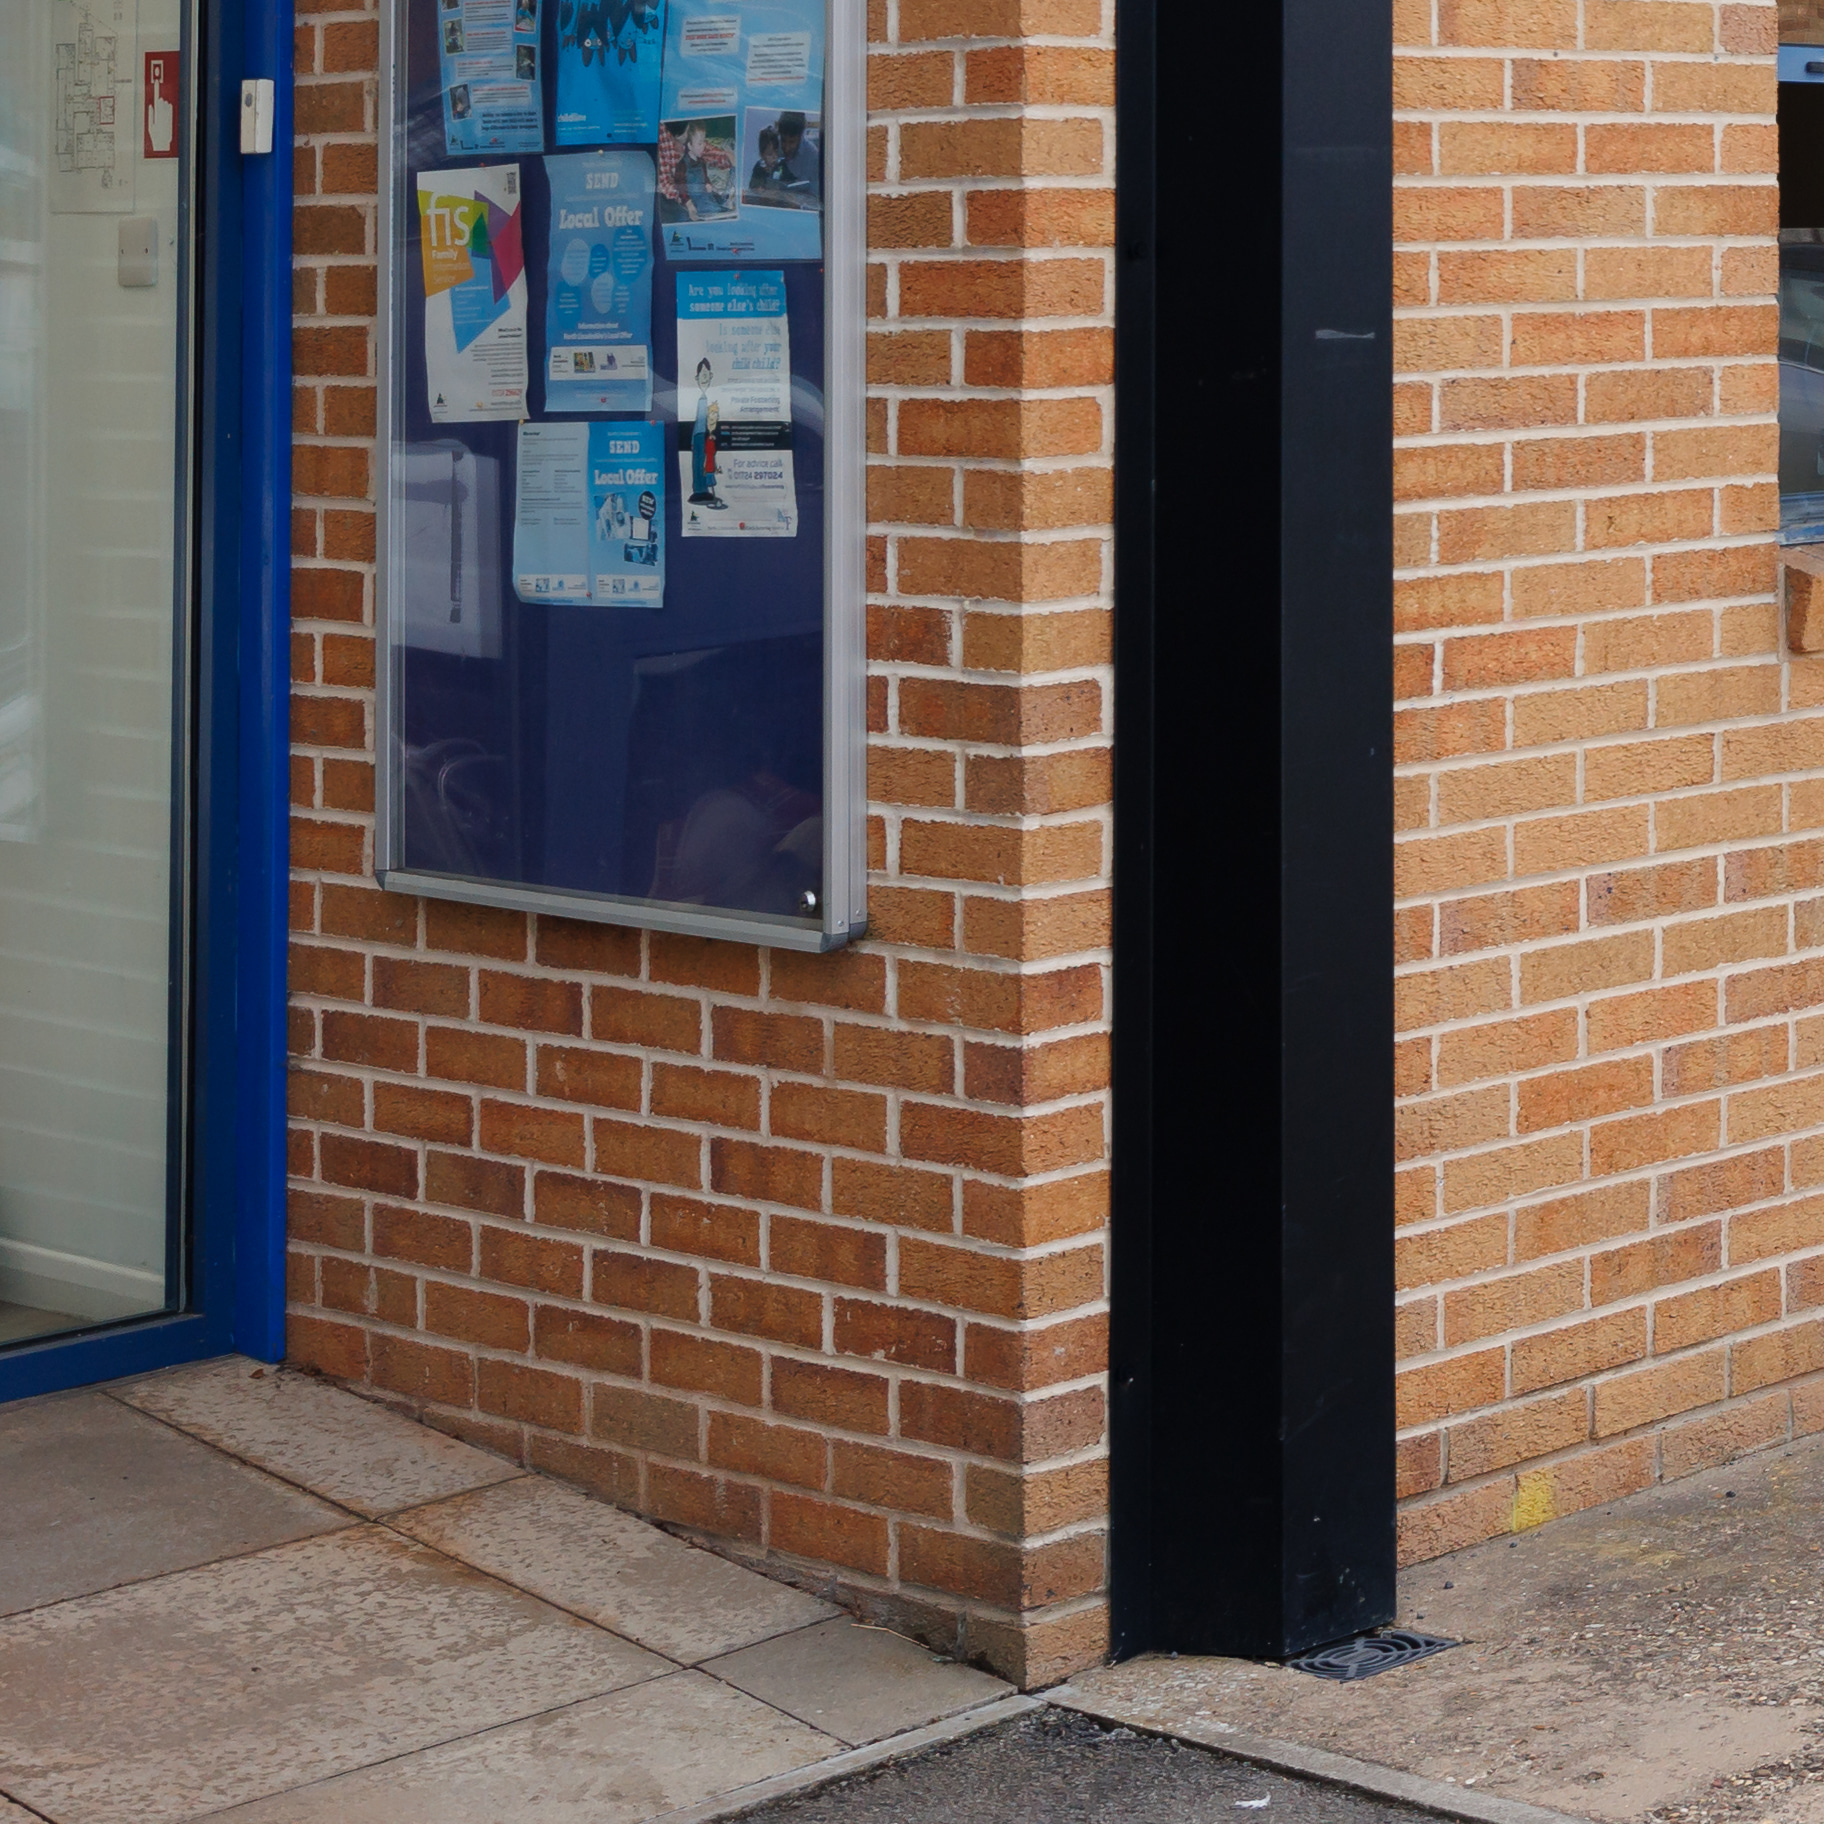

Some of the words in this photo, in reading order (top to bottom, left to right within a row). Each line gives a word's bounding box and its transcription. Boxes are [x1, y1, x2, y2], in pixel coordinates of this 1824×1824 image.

[586, 172, 619, 190] SEND
[426, 190, 470, 246] fis
[559, 207, 600, 229] Local
[604, 205, 643, 227] Offer
[431, 248, 458, 260] Family
[689, 284, 704, 296] Are
[708, 287, 724, 298] you
[727, 283, 756, 298] looking
[689, 302, 724, 312] someone
[727, 298, 754, 312] else's
[609, 440, 640, 454] SEND
[733, 459, 746, 468] For
[746, 459, 769, 468] advice
[769, 459, 783, 468] call
[594, 469, 624, 485] Local
[625, 468, 658, 485] Offer
